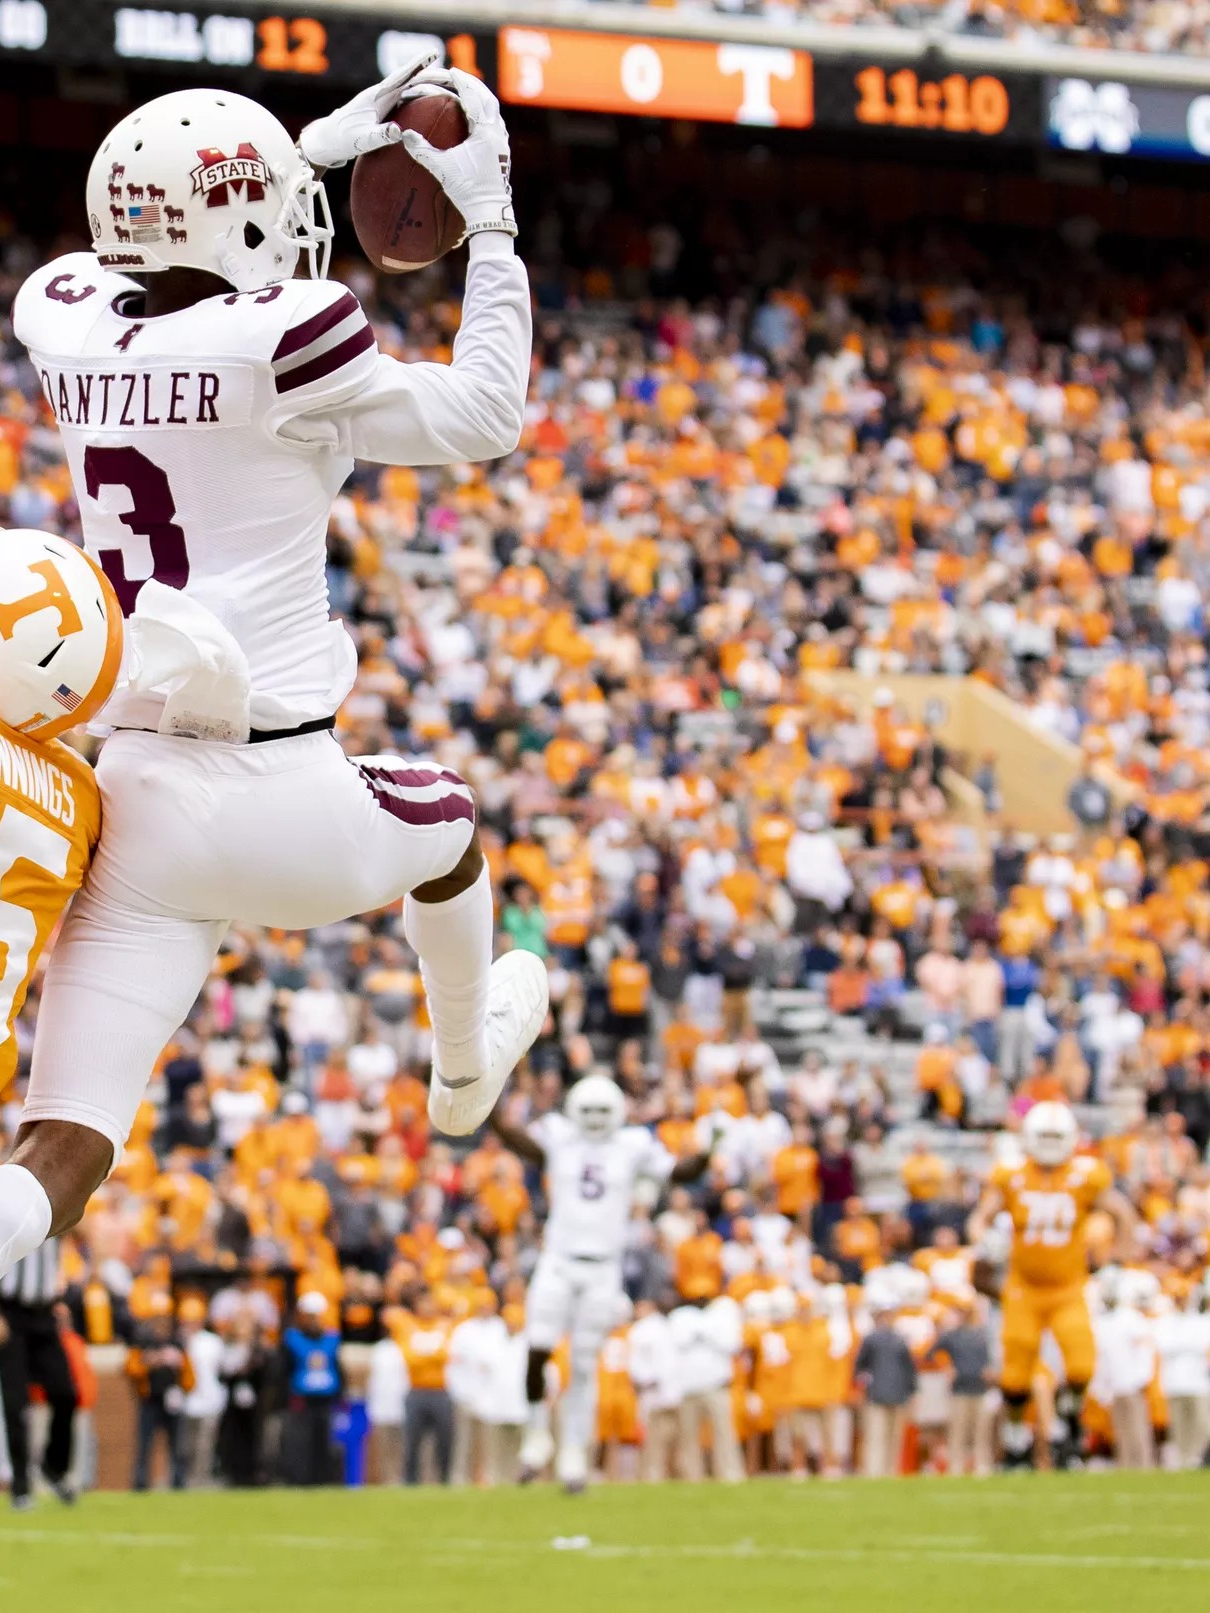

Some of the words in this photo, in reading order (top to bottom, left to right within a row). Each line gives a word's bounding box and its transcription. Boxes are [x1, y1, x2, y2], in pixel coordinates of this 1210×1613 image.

[257, 15, 329, 74] 12
[620, 43, 663, 103] 0
[717, 42, 795, 126] T
[853, 65, 1009, 135] 11:10
[205, 161, 261, 185] STATE
[44, 272, 97, 305] 3
[83, 444, 190, 619] 3
[580, 1163, 606, 1202] 5
